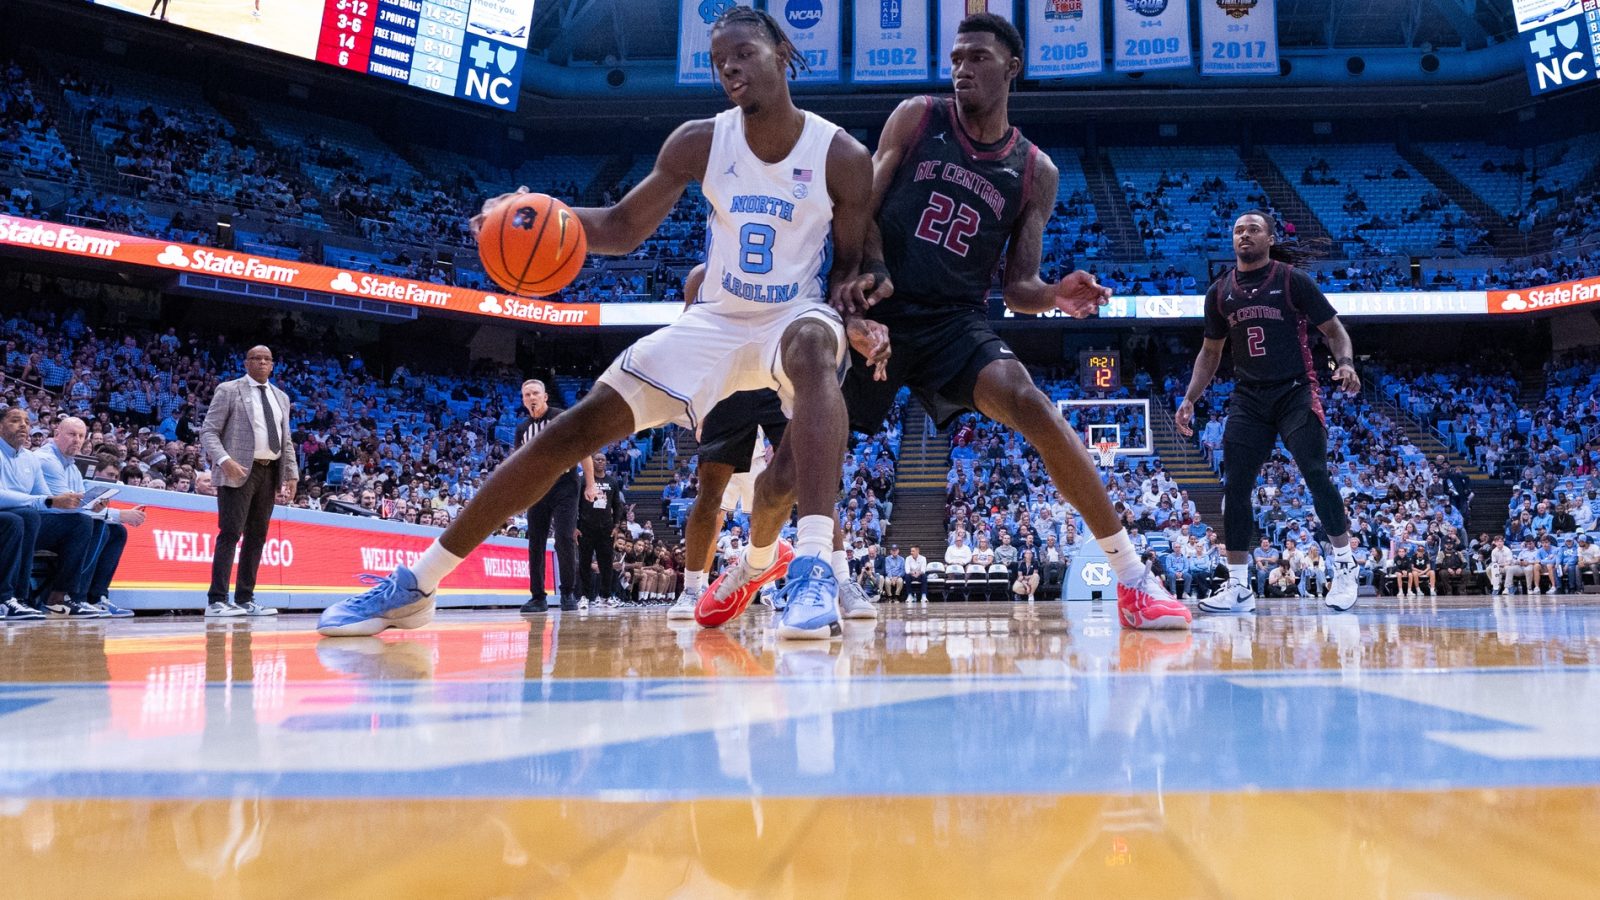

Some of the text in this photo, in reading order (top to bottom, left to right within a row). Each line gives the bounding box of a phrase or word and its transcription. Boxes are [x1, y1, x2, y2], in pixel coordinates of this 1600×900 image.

[336, 0, 368, 16] 3-12
[426, 6, 463, 26] 14-25
[789, 10, 821, 20] NCAA
[337, 14, 362, 32] 3-6
[386, 12, 406, 26] POINT
[339, 33, 355, 49] 14
[374, 27, 416, 47] FREE THROWS
[428, 24, 454, 40] 3-11
[374, 45, 410, 63] REBOUNDS
[424, 40, 452, 58] 8-10
[1040, 42, 1088, 61] 2005
[1125, 37, 1179, 56] 2009
[1212, 41, 1266, 59] 2017
[338, 51, 349, 65] 6
[427, 58, 444, 73] 24
[866, 48, 917, 66] 1982
[1116, 56, 1189, 67] NATIONAL CHAMPIONS
[370, 61, 408, 80] TURNOVERS
[1029, 63, 1061, 72] NATIONAL
[1535, 51, 1588, 90] NC
[425, 75, 441, 89] 10
[464, 68, 513, 105] NC
[914, 160, 1006, 221] NC CENTRAL
[730, 195, 794, 222] NORTH
[914, 191, 981, 257] 22
[739, 222, 776, 274] 8
[722, 270, 799, 303] AROLINA
[1348, 296, 1467, 312] BASKETBALL
[1236, 305, 1284, 322] CENTRAL
[1247, 326, 1266, 357] 2
[1090, 357, 1114, 368] 19:21
[1096, 369, 1112, 387] 12
[153, 529, 215, 563] WELL
[360, 546, 404, 571] WELLS
[483, 556, 511, 577] WELLS
